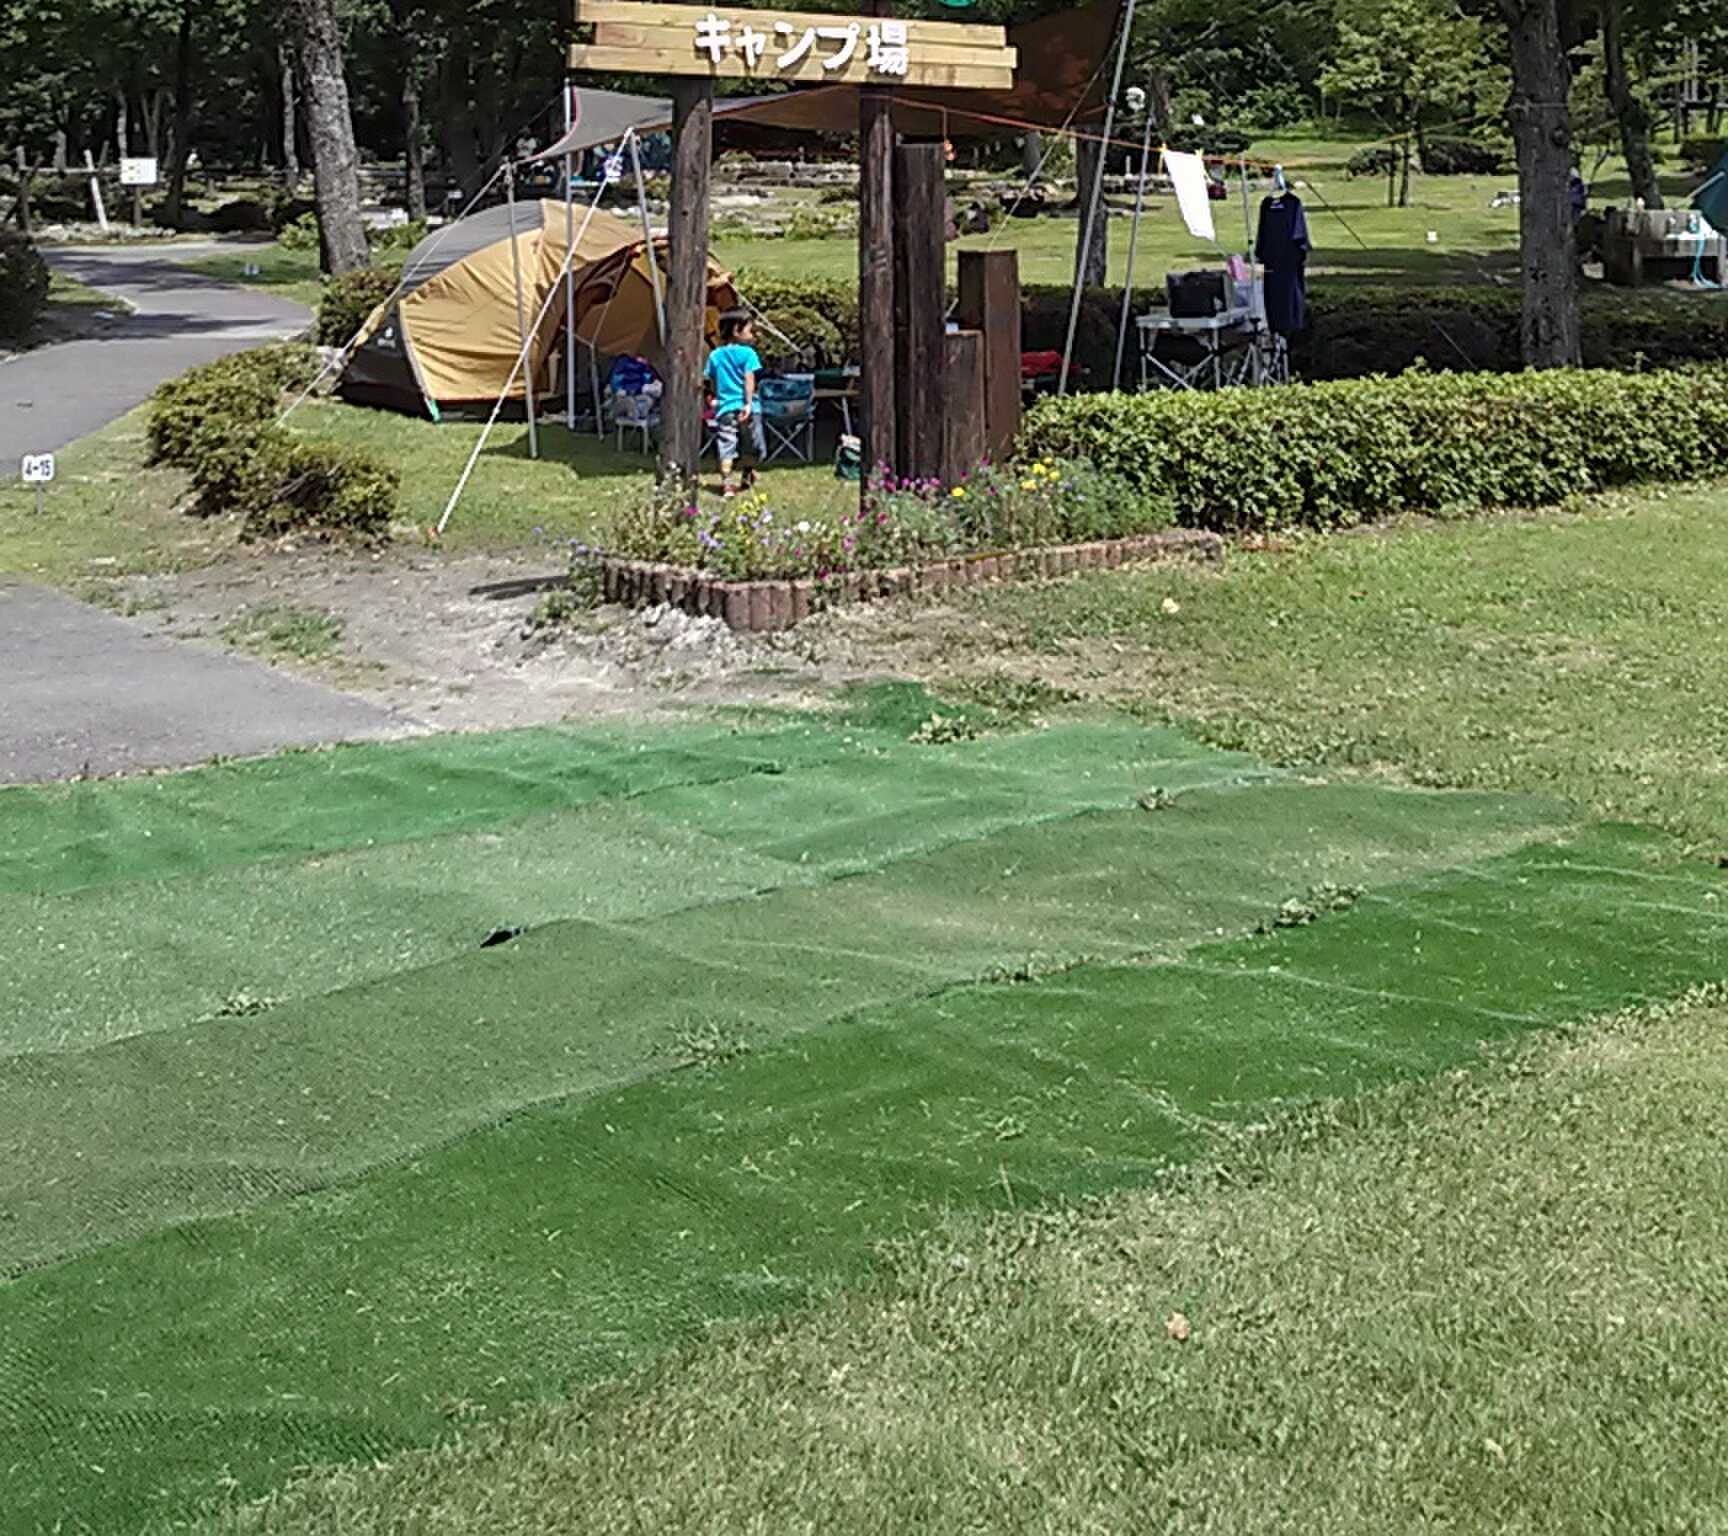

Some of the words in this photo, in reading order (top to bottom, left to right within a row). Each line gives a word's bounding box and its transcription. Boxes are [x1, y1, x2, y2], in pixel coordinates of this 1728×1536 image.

[695, 13, 910, 75] キャンプ場
